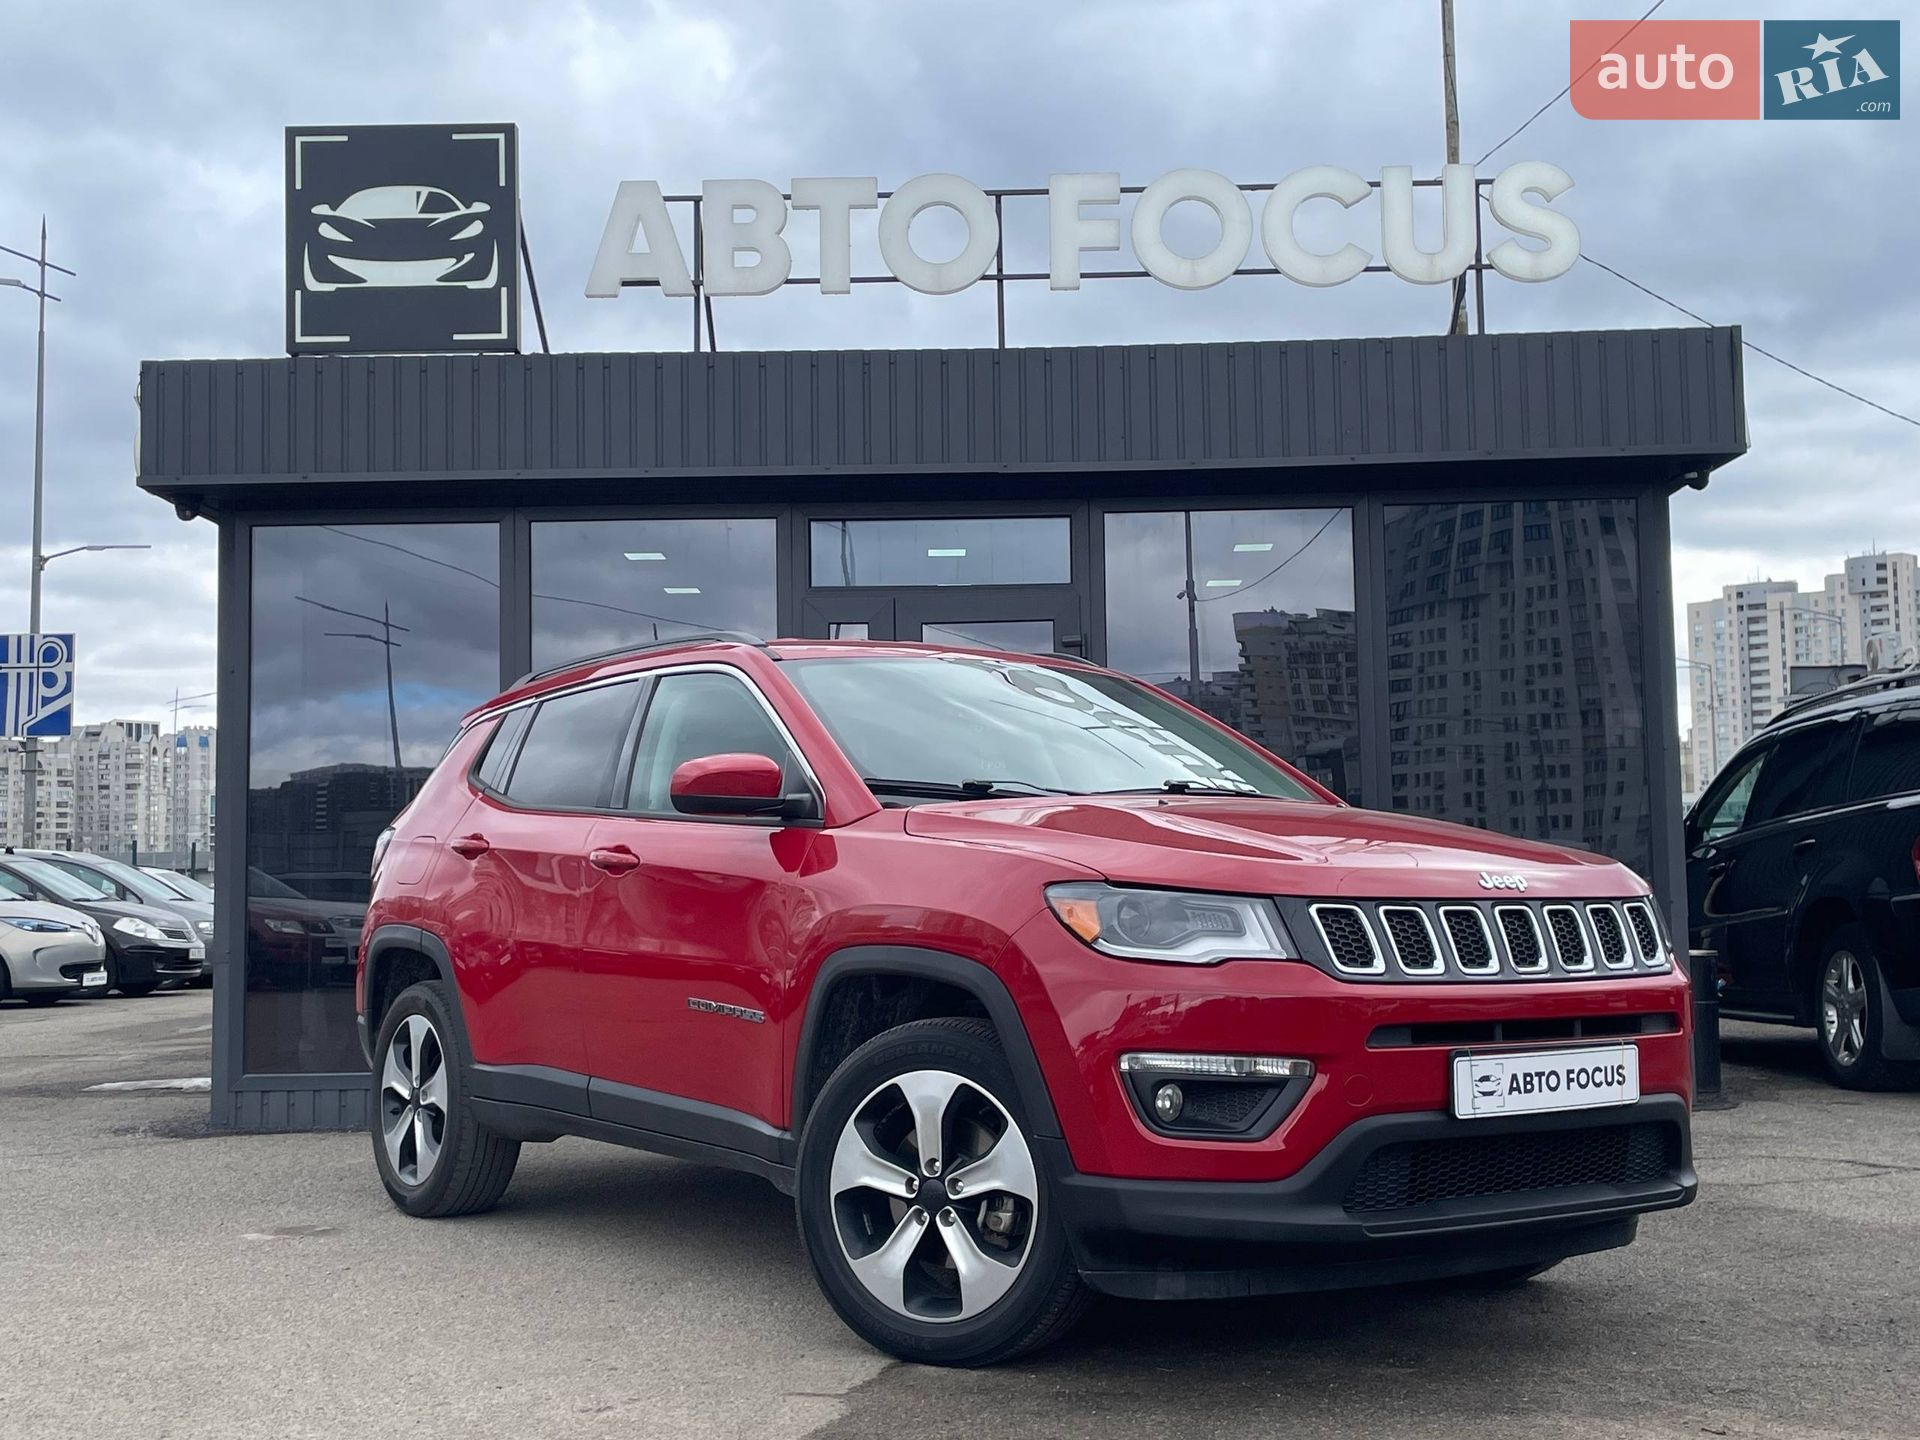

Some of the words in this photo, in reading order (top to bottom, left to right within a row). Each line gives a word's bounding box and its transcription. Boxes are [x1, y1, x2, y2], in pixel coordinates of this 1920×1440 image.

[1049, 160, 1581, 290] FOCUS
[1478, 871, 1528, 892] Jeep
[1566, 1064, 1626, 1090] FOCUS
